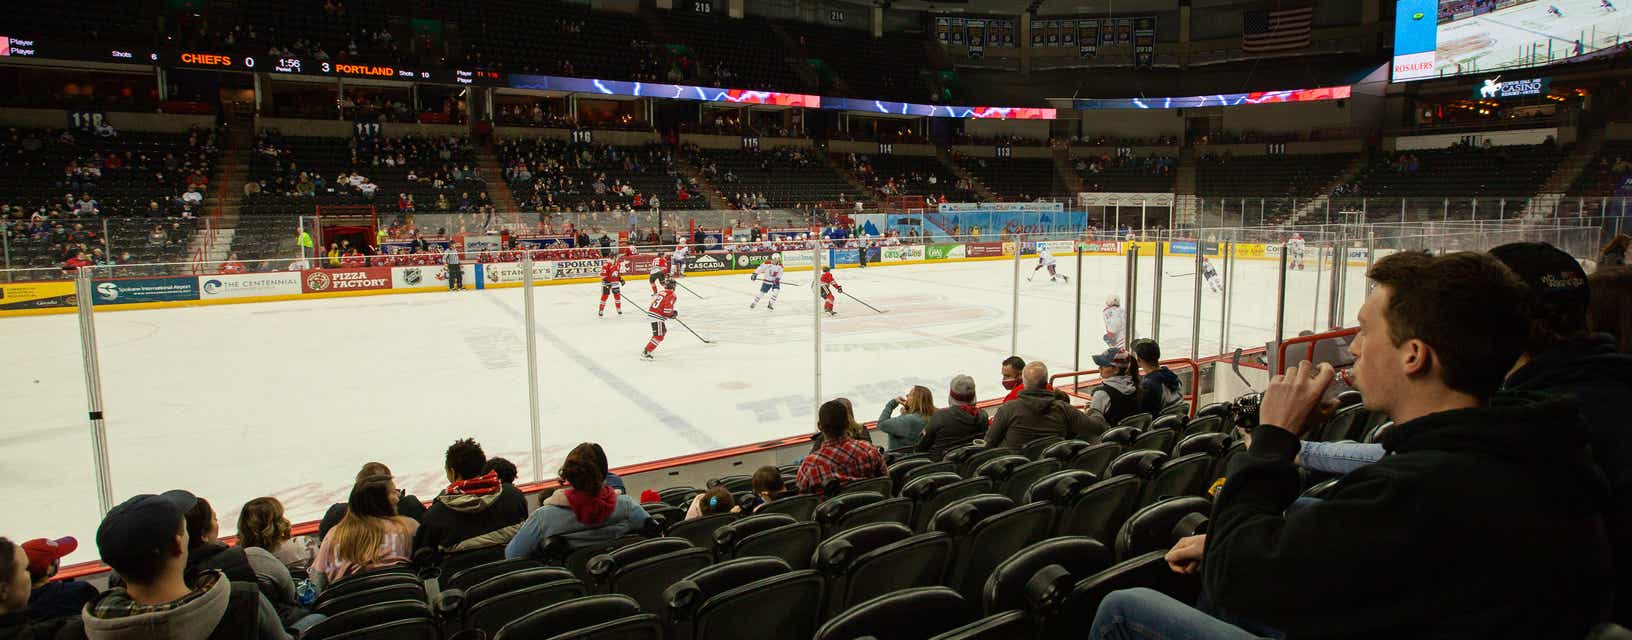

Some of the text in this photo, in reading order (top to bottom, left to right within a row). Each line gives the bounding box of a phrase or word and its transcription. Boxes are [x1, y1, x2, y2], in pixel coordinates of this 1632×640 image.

[695, 2, 711, 14] 215
[10, 38, 34, 47] Player
[11, 47, 35, 56] Player
[112, 50, 132, 59] Shots
[180, 53, 232, 66] CHIEFS
[245, 57, 255, 68] 0
[279, 58, 301, 68] 1:56
[321, 63, 330, 73] 3
[335, 64, 394, 76] PORTLAND
[1395, 62, 1433, 72] ROSAUERS
[1501, 82, 1542, 92] CASINO
[356, 123, 381, 136] 117
[573, 130, 592, 144] 116
[743, 137, 759, 149] 115
[880, 143, 892, 155] 114
[1268, 144, 1285, 154] 111
[688, 262, 726, 270] CASCADIA
[332, 271, 367, 281] PIZZA
[554, 266, 602, 278] AZTEC
[242, 279, 297, 288] CENTENNIAL
[333, 278, 385, 289] FACTORY
